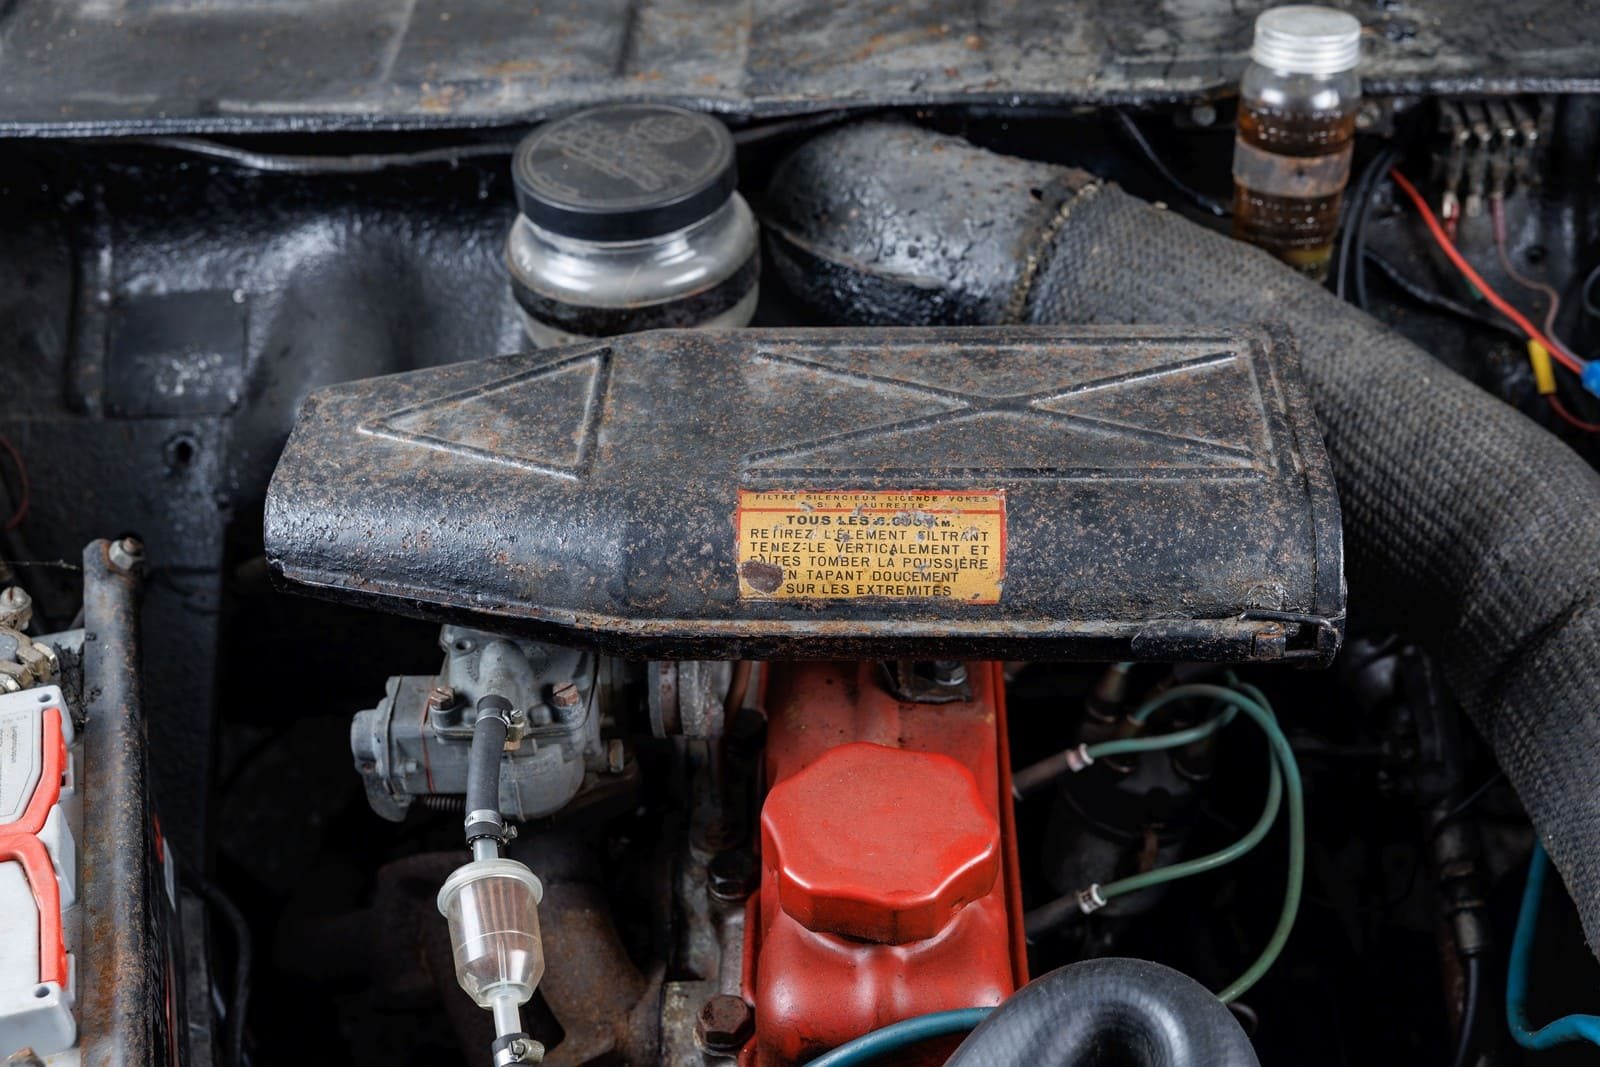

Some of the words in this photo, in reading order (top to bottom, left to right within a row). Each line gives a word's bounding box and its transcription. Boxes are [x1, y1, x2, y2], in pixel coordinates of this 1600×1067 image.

[786, 515, 831, 526] TOUS
[838, 516, 870, 526] LES
[750, 528, 814, 539] RETIREZ
[918, 530, 989, 542] FILTRANT
[836, 543, 960, 556] VERTICALEMENT
[971, 545, 990, 556] ET
[809, 556, 870, 568] TOMBER
[878, 558, 895, 568] LA
[903, 556, 989, 570] POUSSIÈRE
[807, 570, 864, 581] TAPANT
[872, 571, 959, 583] DOUCEMENT
[786, 583, 816, 594] SUR
[822, 584, 850, 595] LES
